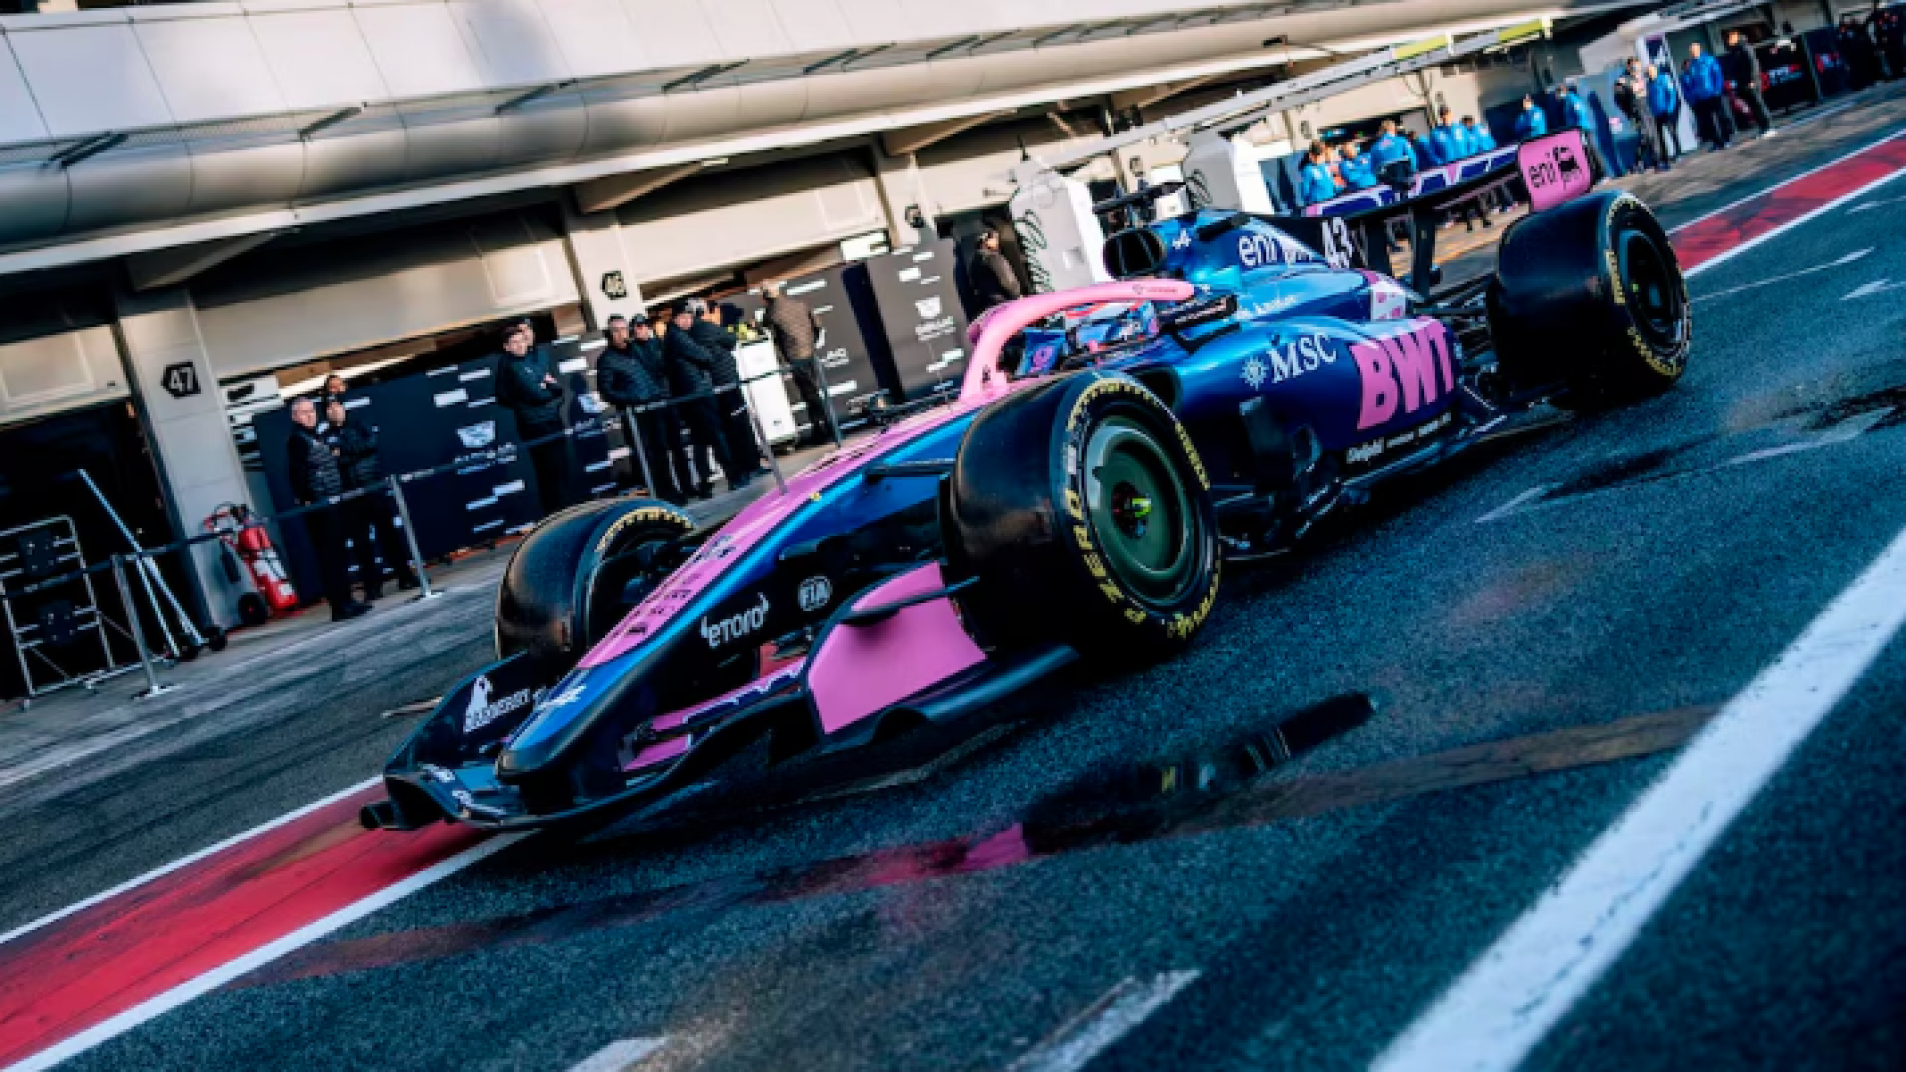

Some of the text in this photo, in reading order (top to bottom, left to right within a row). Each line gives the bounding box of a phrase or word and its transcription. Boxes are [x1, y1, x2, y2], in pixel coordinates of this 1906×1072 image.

[1529, 151, 1557, 188] eni
[1238, 234, 1278, 266] eni
[1265, 330, 1338, 384] MSC
[170, 366, 194, 391] 47
[1063, 486, 1125, 604] ZERO
[799, 581, 829, 608] FIA
